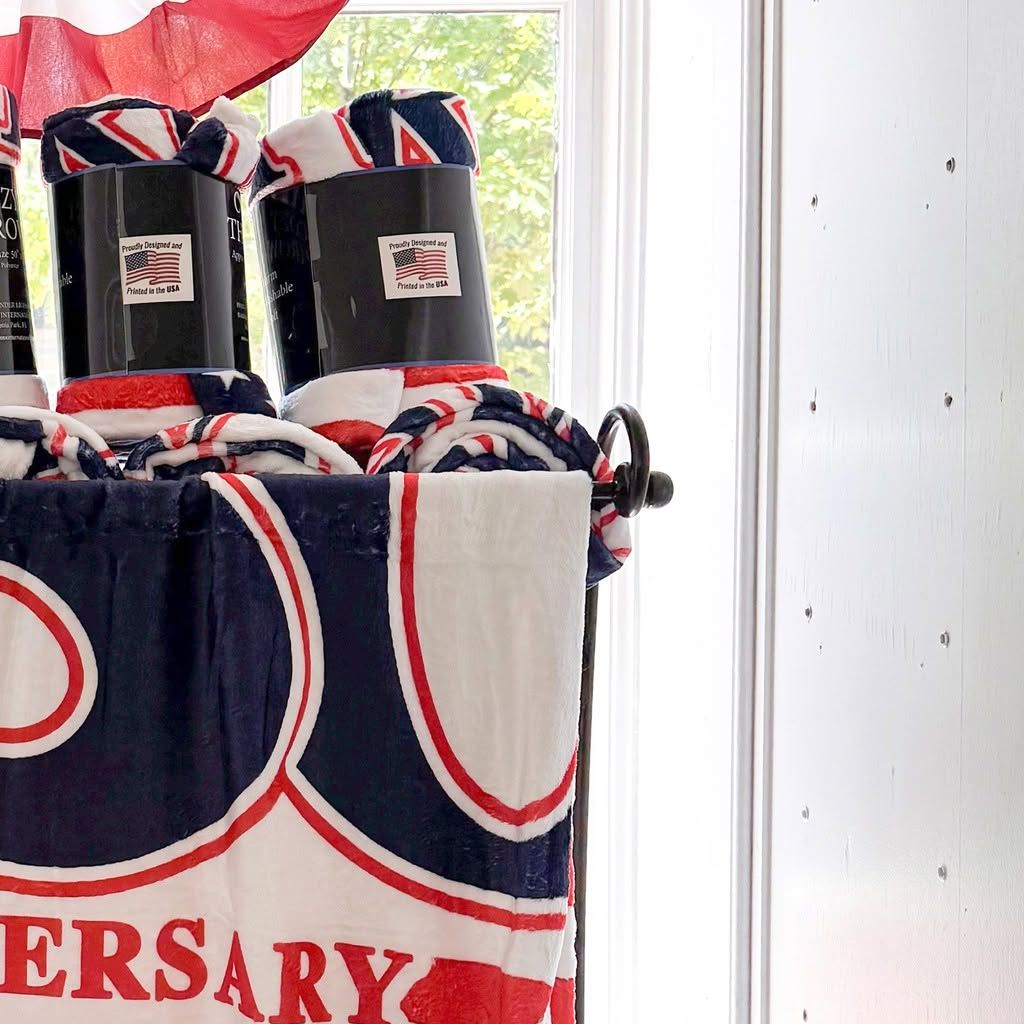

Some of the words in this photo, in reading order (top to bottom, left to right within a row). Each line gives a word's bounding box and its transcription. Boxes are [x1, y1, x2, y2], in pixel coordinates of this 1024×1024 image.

[122, 243, 143, 253] Proudly
[144, 241, 171, 249] Designed
[389, 240, 410, 250] Proudly
[411, 239, 436, 247] Designed
[126, 287, 147, 295] Printed
[156, 286, 165, 294] the
[166, 284, 180, 293] USA
[436, 280, 448, 288] USA
